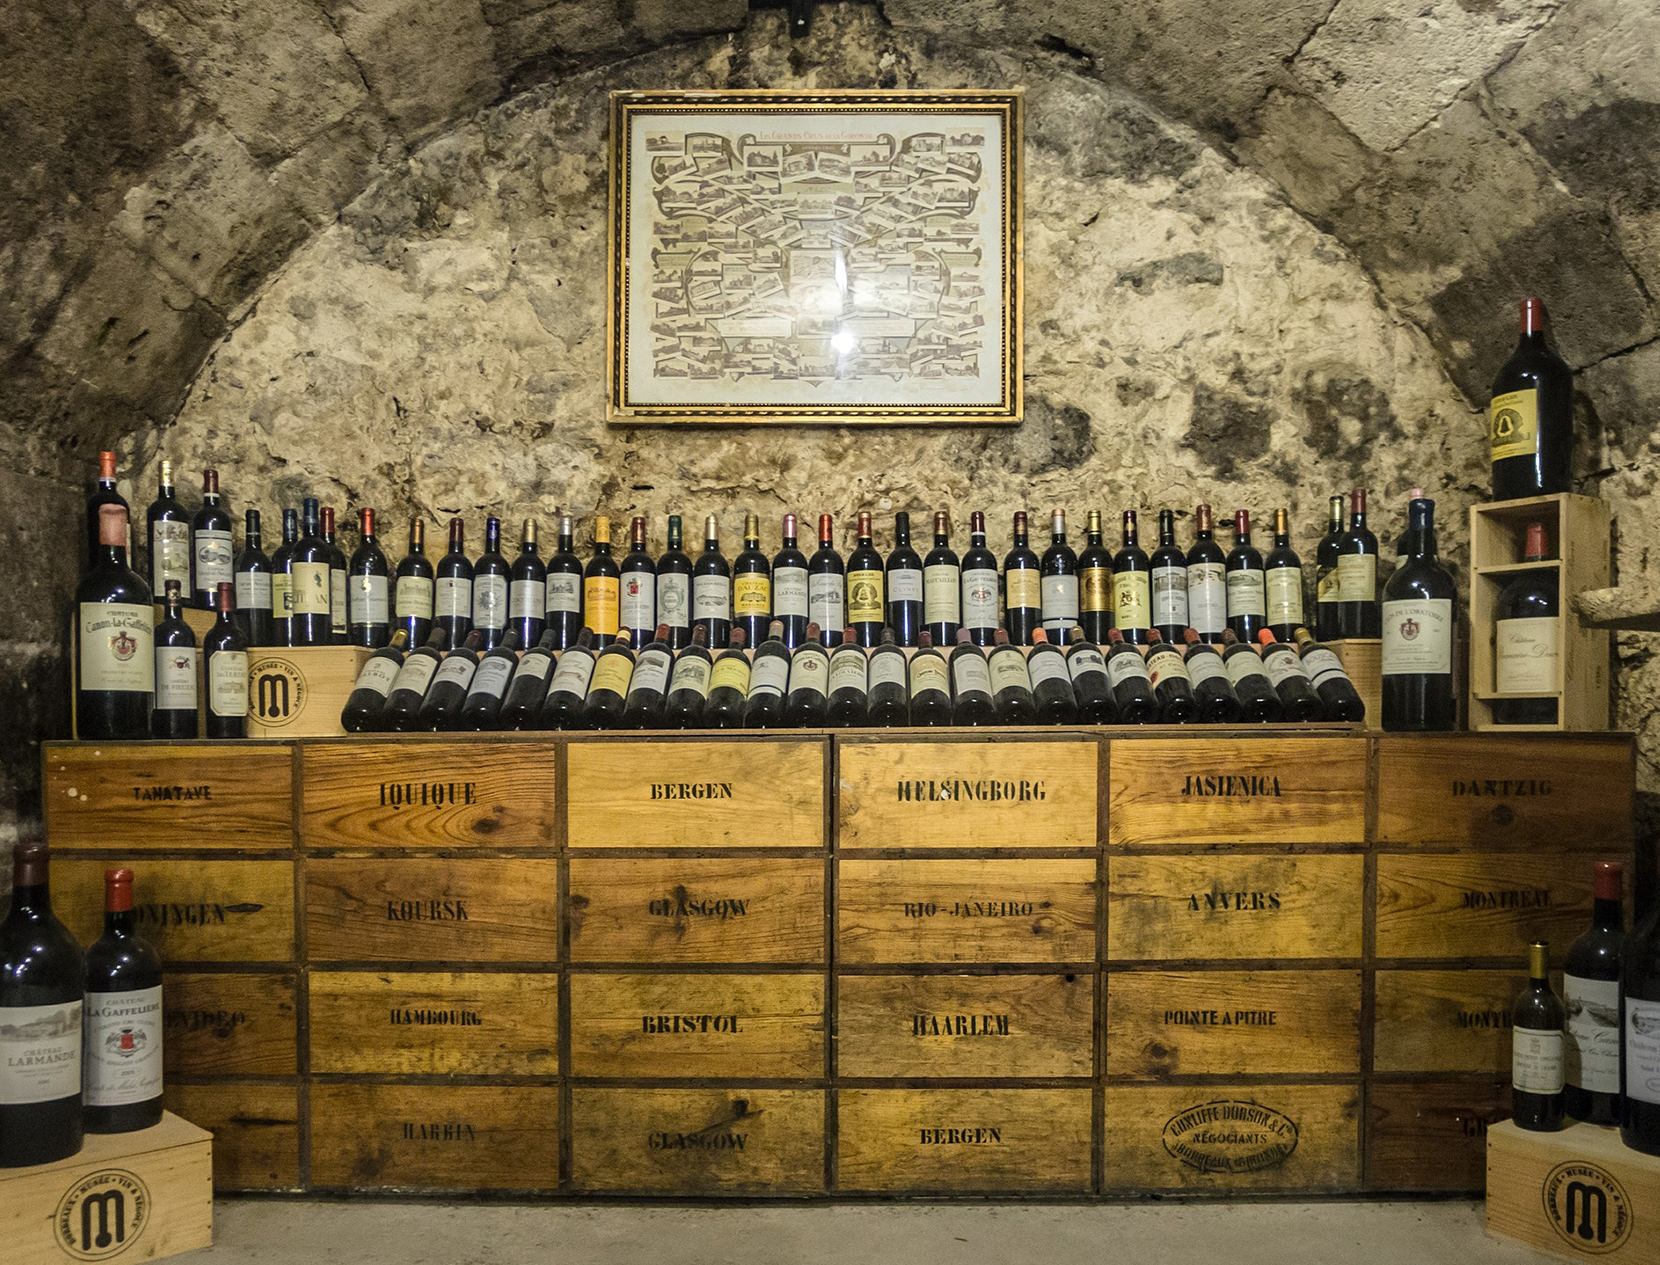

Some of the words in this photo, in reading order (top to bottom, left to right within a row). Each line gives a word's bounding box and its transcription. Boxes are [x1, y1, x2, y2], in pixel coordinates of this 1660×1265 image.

[378, 781, 478, 811] IQUIQUE
[649, 782, 734, 800] BERGEN
[897, 780, 1047, 802] HELSINGBORG
[1181, 775, 1282, 797] JASIENICA
[1452, 779, 1553, 797] DANTZIG
[386, 900, 470, 921] KOURSK
[648, 898, 750, 919] GLASGOW
[1187, 891, 1282, 911] ANVERS
[389, 1007, 483, 1027] HAMBOURG
[641, 1015, 744, 1035] BRISTOL
[911, 1014, 1010, 1037] HAARLEM
[1163, 1009, 1220, 1026] POINTE
[1221, 1009, 1233, 1025] A
[1234, 1010, 1278, 1026] PITRE
[7, 1050, 76, 1068] LARMANDE
[403, 1122, 477, 1142] HARBIN
[647, 1132, 749, 1152] GLASGOW
[919, 1127, 1002, 1146] BERGEN
